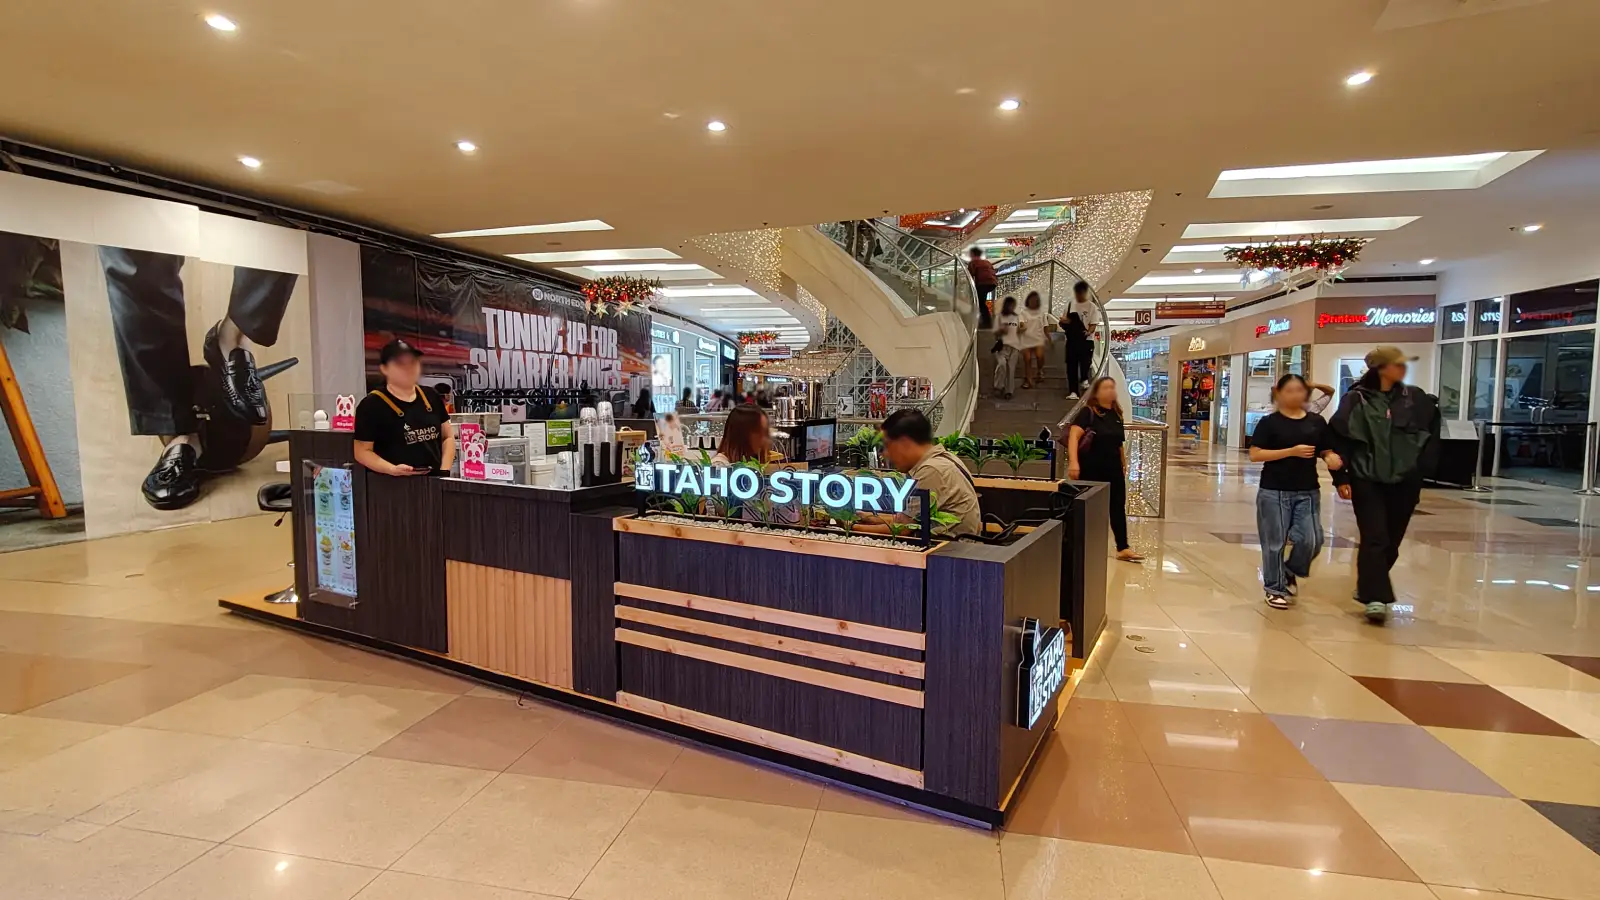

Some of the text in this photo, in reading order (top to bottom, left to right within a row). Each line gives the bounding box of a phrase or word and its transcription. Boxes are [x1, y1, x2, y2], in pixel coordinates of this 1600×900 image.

[543, 292, 571, 305] NORTH
[1136, 312, 1151, 324] UG
[1365, 307, 1436, 326] Memories
[482, 306, 618, 359] TUNING UP FOR
[469, 347, 569, 390] SMARTER
[415, 426, 437, 436] TAHO
[417, 432, 440, 442] STORY
[491, 468, 507, 476] OPEN
[655, 463, 759, 499] TAHO
[770, 470, 916, 513] STORY
[1043, 631, 1065, 678] TAHO
[1042, 648, 1066, 708] STORY
